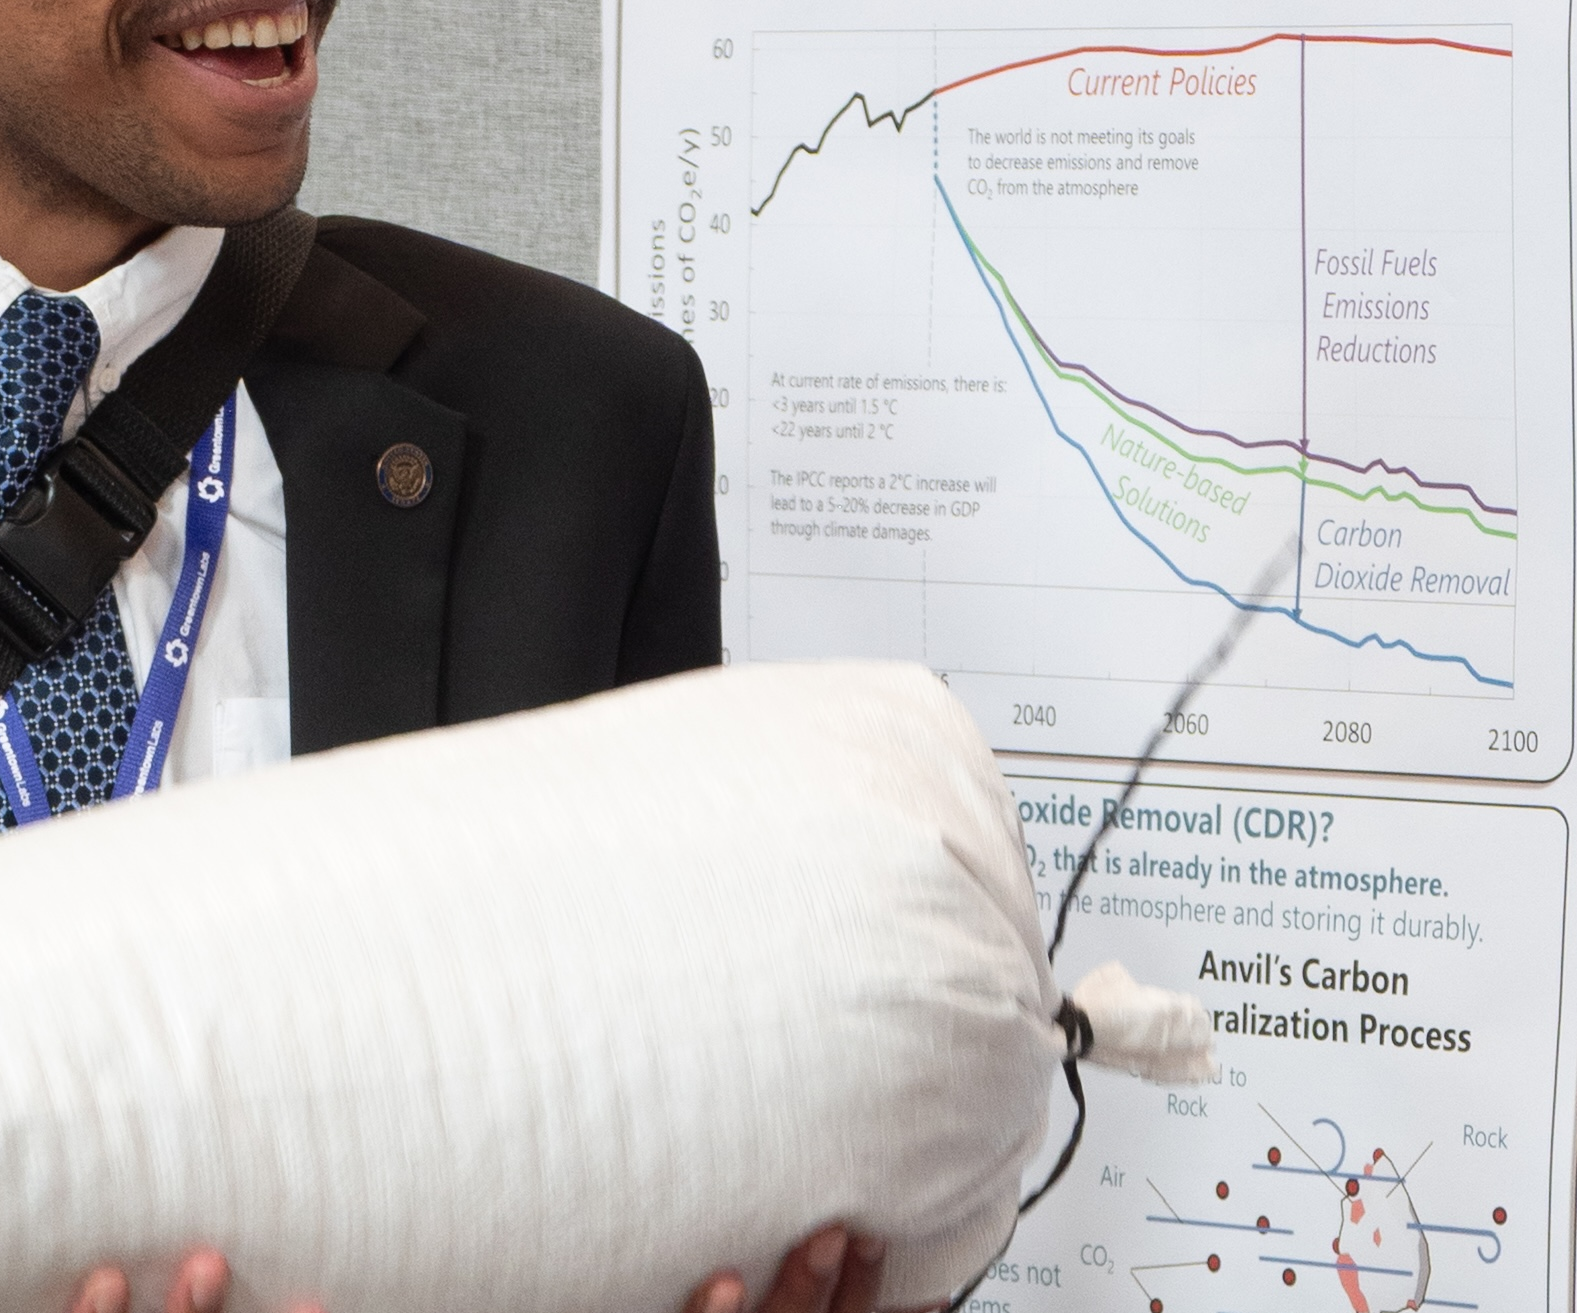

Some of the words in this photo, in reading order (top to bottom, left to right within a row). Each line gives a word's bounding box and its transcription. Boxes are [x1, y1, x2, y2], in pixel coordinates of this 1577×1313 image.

[713, 38, 734, 59] 60
[1068, 67, 1161, 96] Current
[1169, 66, 1257, 96] Policies
[710, 126, 732, 148] 50
[968, 127, 991, 145] The
[995, 127, 1032, 145] world
[1036, 128, 1046, 144] is
[1052, 129, 1073, 145] not
[1077, 128, 1133, 149] meeting
[1138, 128, 1154, 145] its
[1158, 128, 1195, 149] goals
[968, 155, 981, 170] to
[985, 154, 1044, 170] decrease
[1047, 154, 1111, 171] emissions
[1116, 154, 1142, 170] and
[1147, 157, 1199, 171] remove
[997, 178, 1029, 195] from
[1033, 178, 1054, 196] the
[1057, 178, 1139, 199] atmosphere
[710, 214, 731, 235] 40
[1315, 249, 1373, 276] Fossil
[1381, 249, 1437, 277] Fuels
[709, 301, 730, 322] 30
[1322, 292, 1430, 320] Emissions
[1316, 335, 1437, 364] Reductions
[1100, 423, 1252, 516] Nature-based
[1112, 475, 1211, 545] Solutions
[1317, 519, 1402, 549] Carbon
[1314, 562, 1403, 593] Dioxide
[1410, 565, 1511, 596] Removal
[179, 576, 206, 638] Greentown
[197, 550, 211, 578] Labs
[146, 719, 164, 746] Labs
[1013, 704, 1057, 728] 2040
[1162, 712, 1210, 736] 2060
[1322, 721, 1373, 744] 2080
[1488, 729, 1539, 754] 2100
[1102, 798, 1222, 837] Removal
[1232, 806, 1334, 848] (CDR)?
[1105, 849, 1122, 875] is
[1129, 851, 1211, 888] already
[1220, 857, 1241, 884] in
[1249, 859, 1287, 887] the
[1294, 863, 1449, 901] atmosphere.
[1100, 891, 1226, 929] atmosphere
[1233, 899, 1274, 928] and
[1282, 904, 1362, 941] storing
[1370, 908, 1385, 935] it
[1392, 910, 1483, 950] durably.
[1198, 949, 1292, 987] Anvil's
[1302, 958, 1409, 996] Carbon
[1213, 1005, 1348, 1043] ralization
[1359, 1013, 1472, 1054] Process
[1167, 1092, 1208, 1118] Rock
[1462, 1123, 1508, 1151] Rock
[1100, 1164, 1126, 1188] Air
